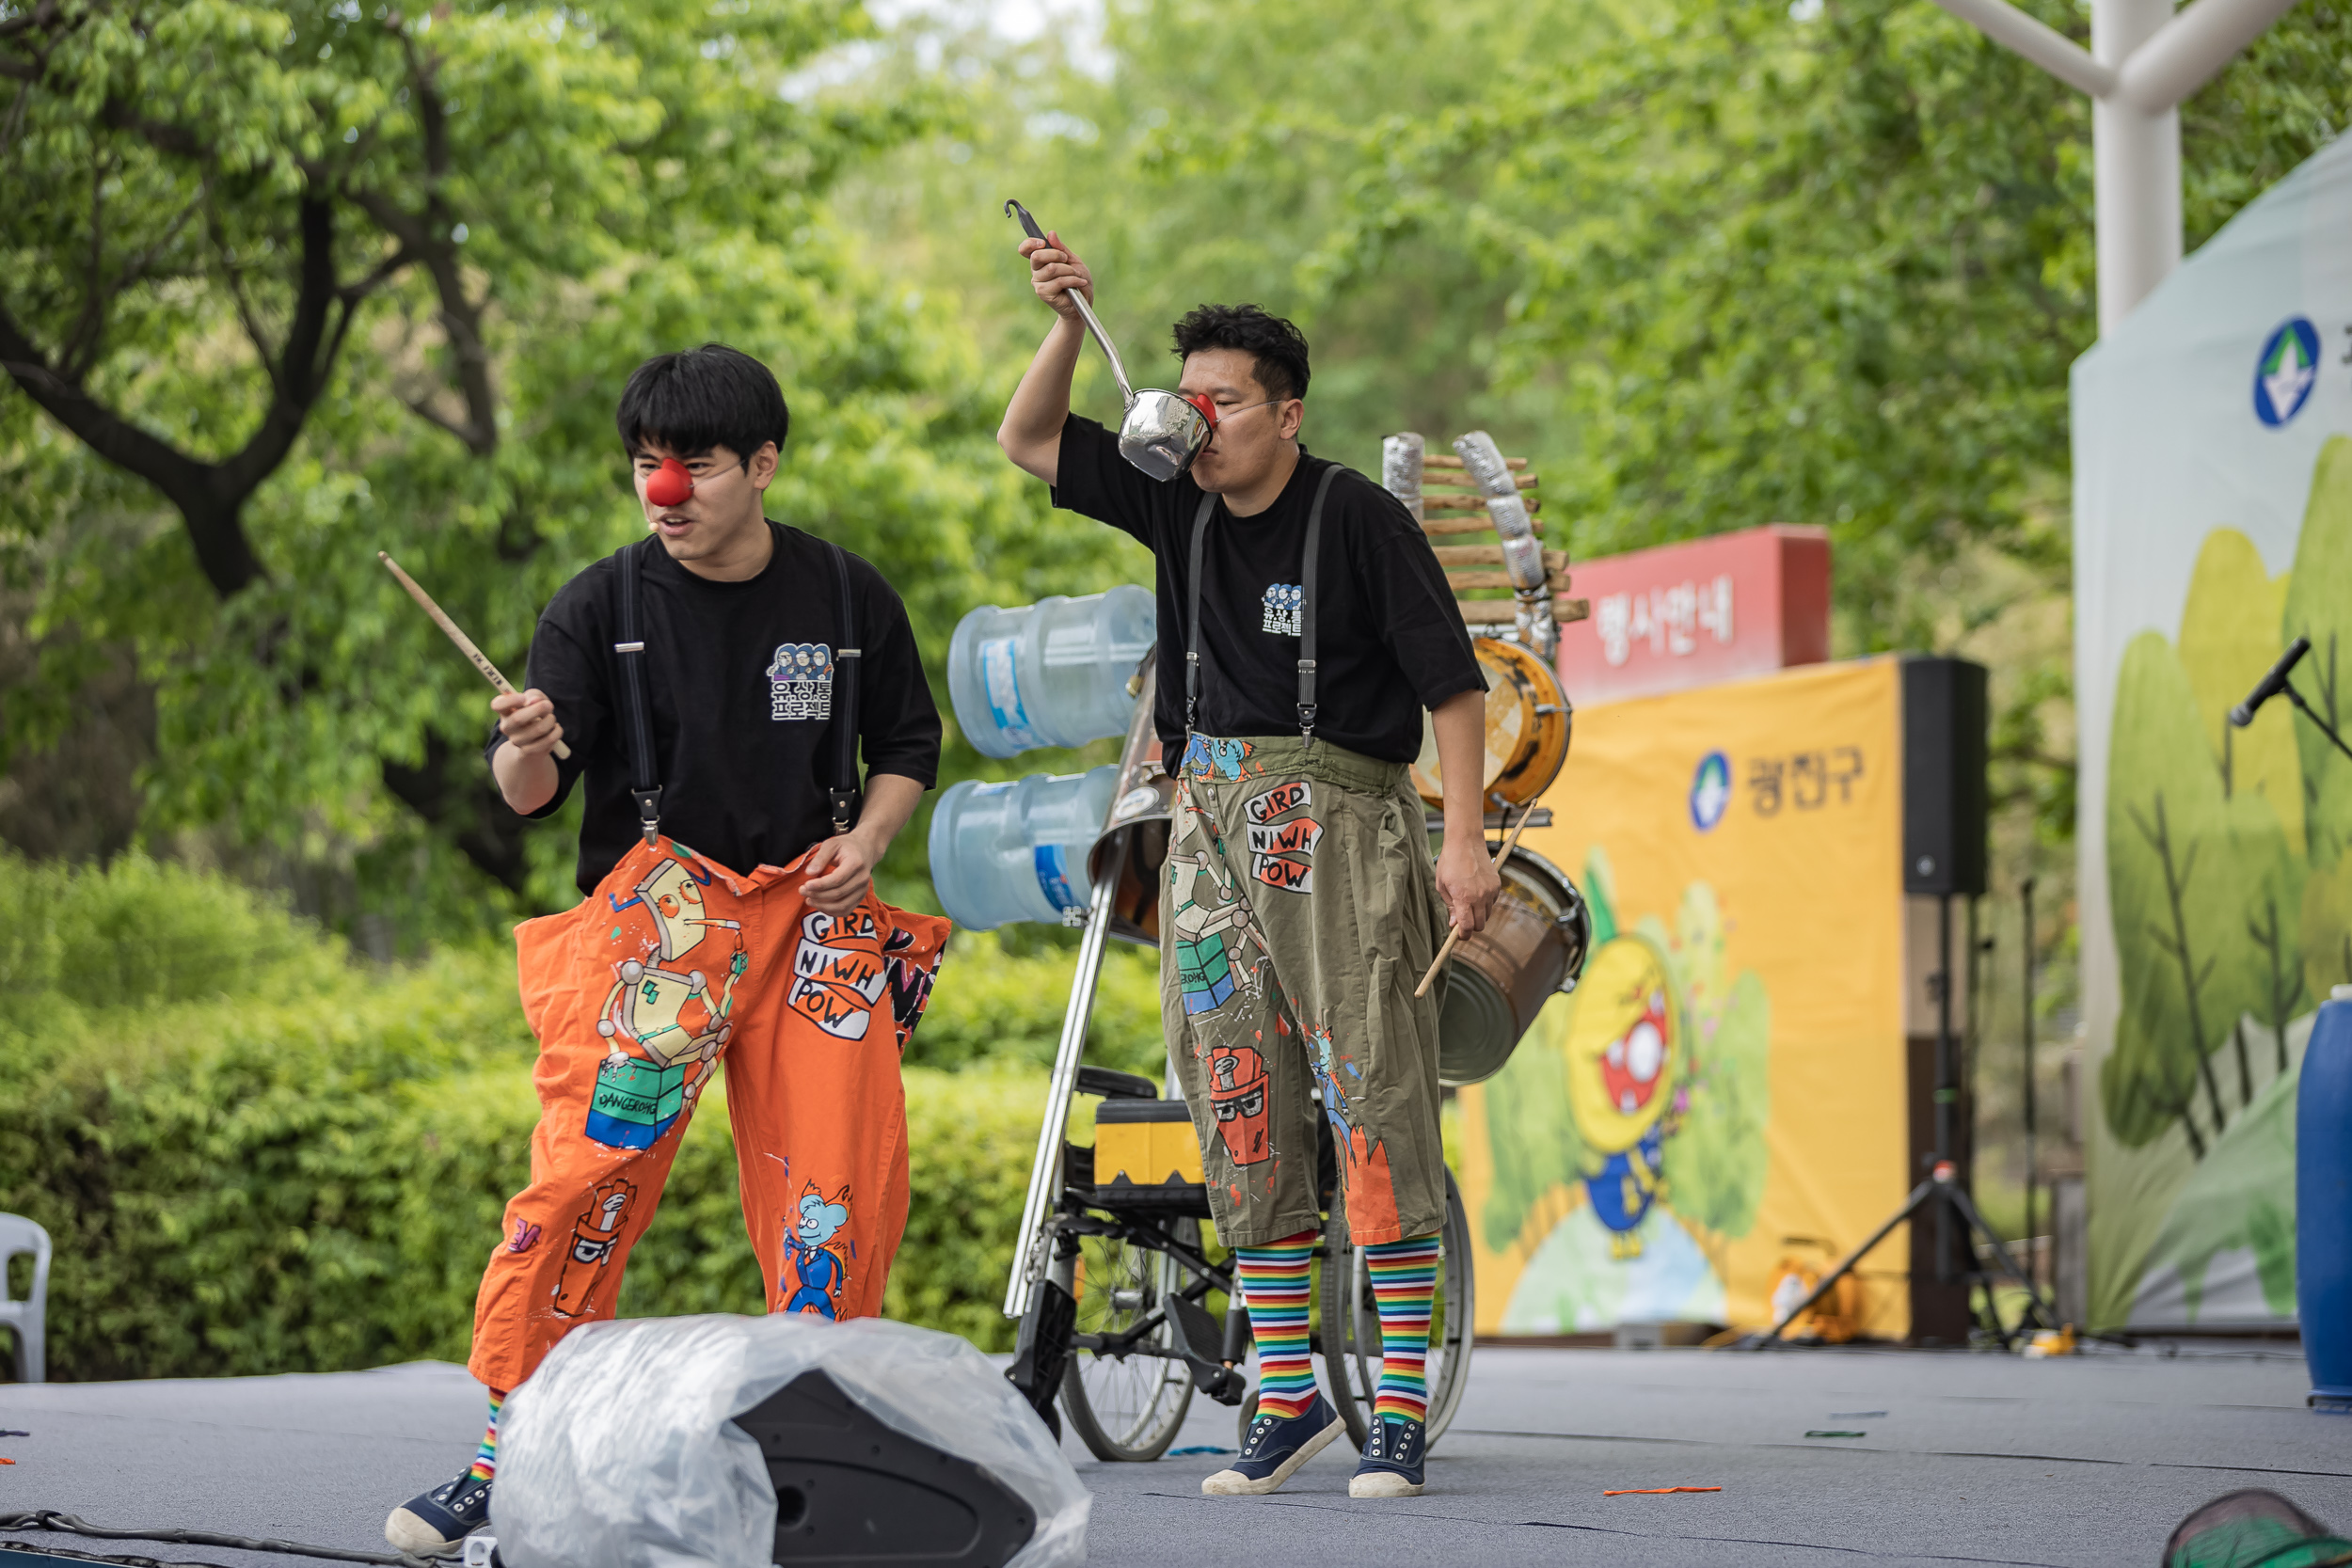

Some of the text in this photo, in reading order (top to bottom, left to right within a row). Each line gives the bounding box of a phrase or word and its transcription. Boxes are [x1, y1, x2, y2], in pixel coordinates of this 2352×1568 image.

[1263, 619, 1301, 637] 프로젝트
[772, 700, 831, 721] 프로젝트
[1748, 745, 1864, 819] 광진구
[1250, 786, 1305, 820] GIRD
[1252, 826, 1311, 851] NIWH
[1259, 854, 1308, 888] POW
[811, 911, 875, 940] GIRD
[800, 949, 876, 990] NIWH
[795, 980, 854, 1029] POW
